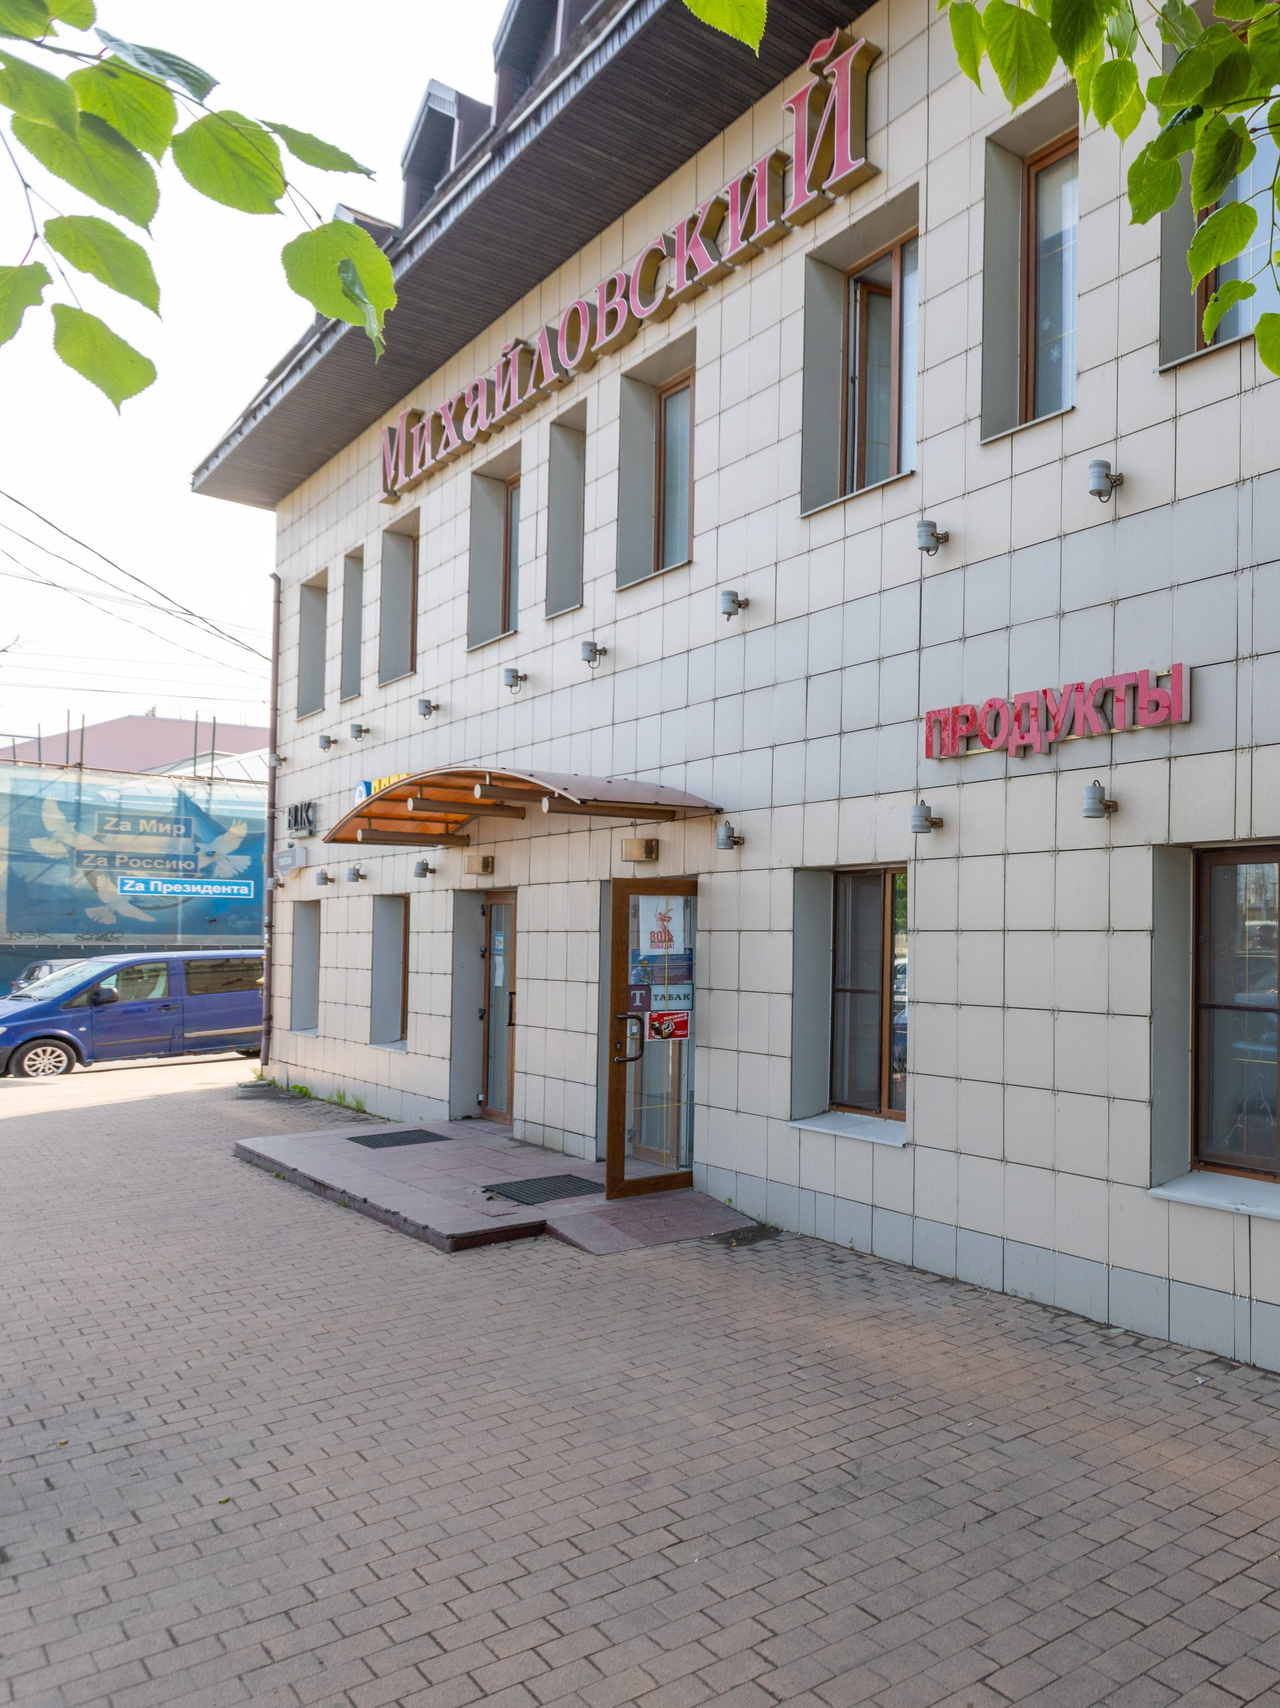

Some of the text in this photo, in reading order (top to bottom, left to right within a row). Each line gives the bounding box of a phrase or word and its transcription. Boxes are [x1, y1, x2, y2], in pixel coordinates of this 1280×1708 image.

[379, 27, 881, 503] Михайловский
[925, 662, 1190, 759] ПРОДУКТЫ
[103, 816, 186, 838] Za Мир
[81, 852, 195, 871] Za Россию
[122, 879, 250, 896] Za Президента
[653, 993, 691, 1002] ТАБАК
